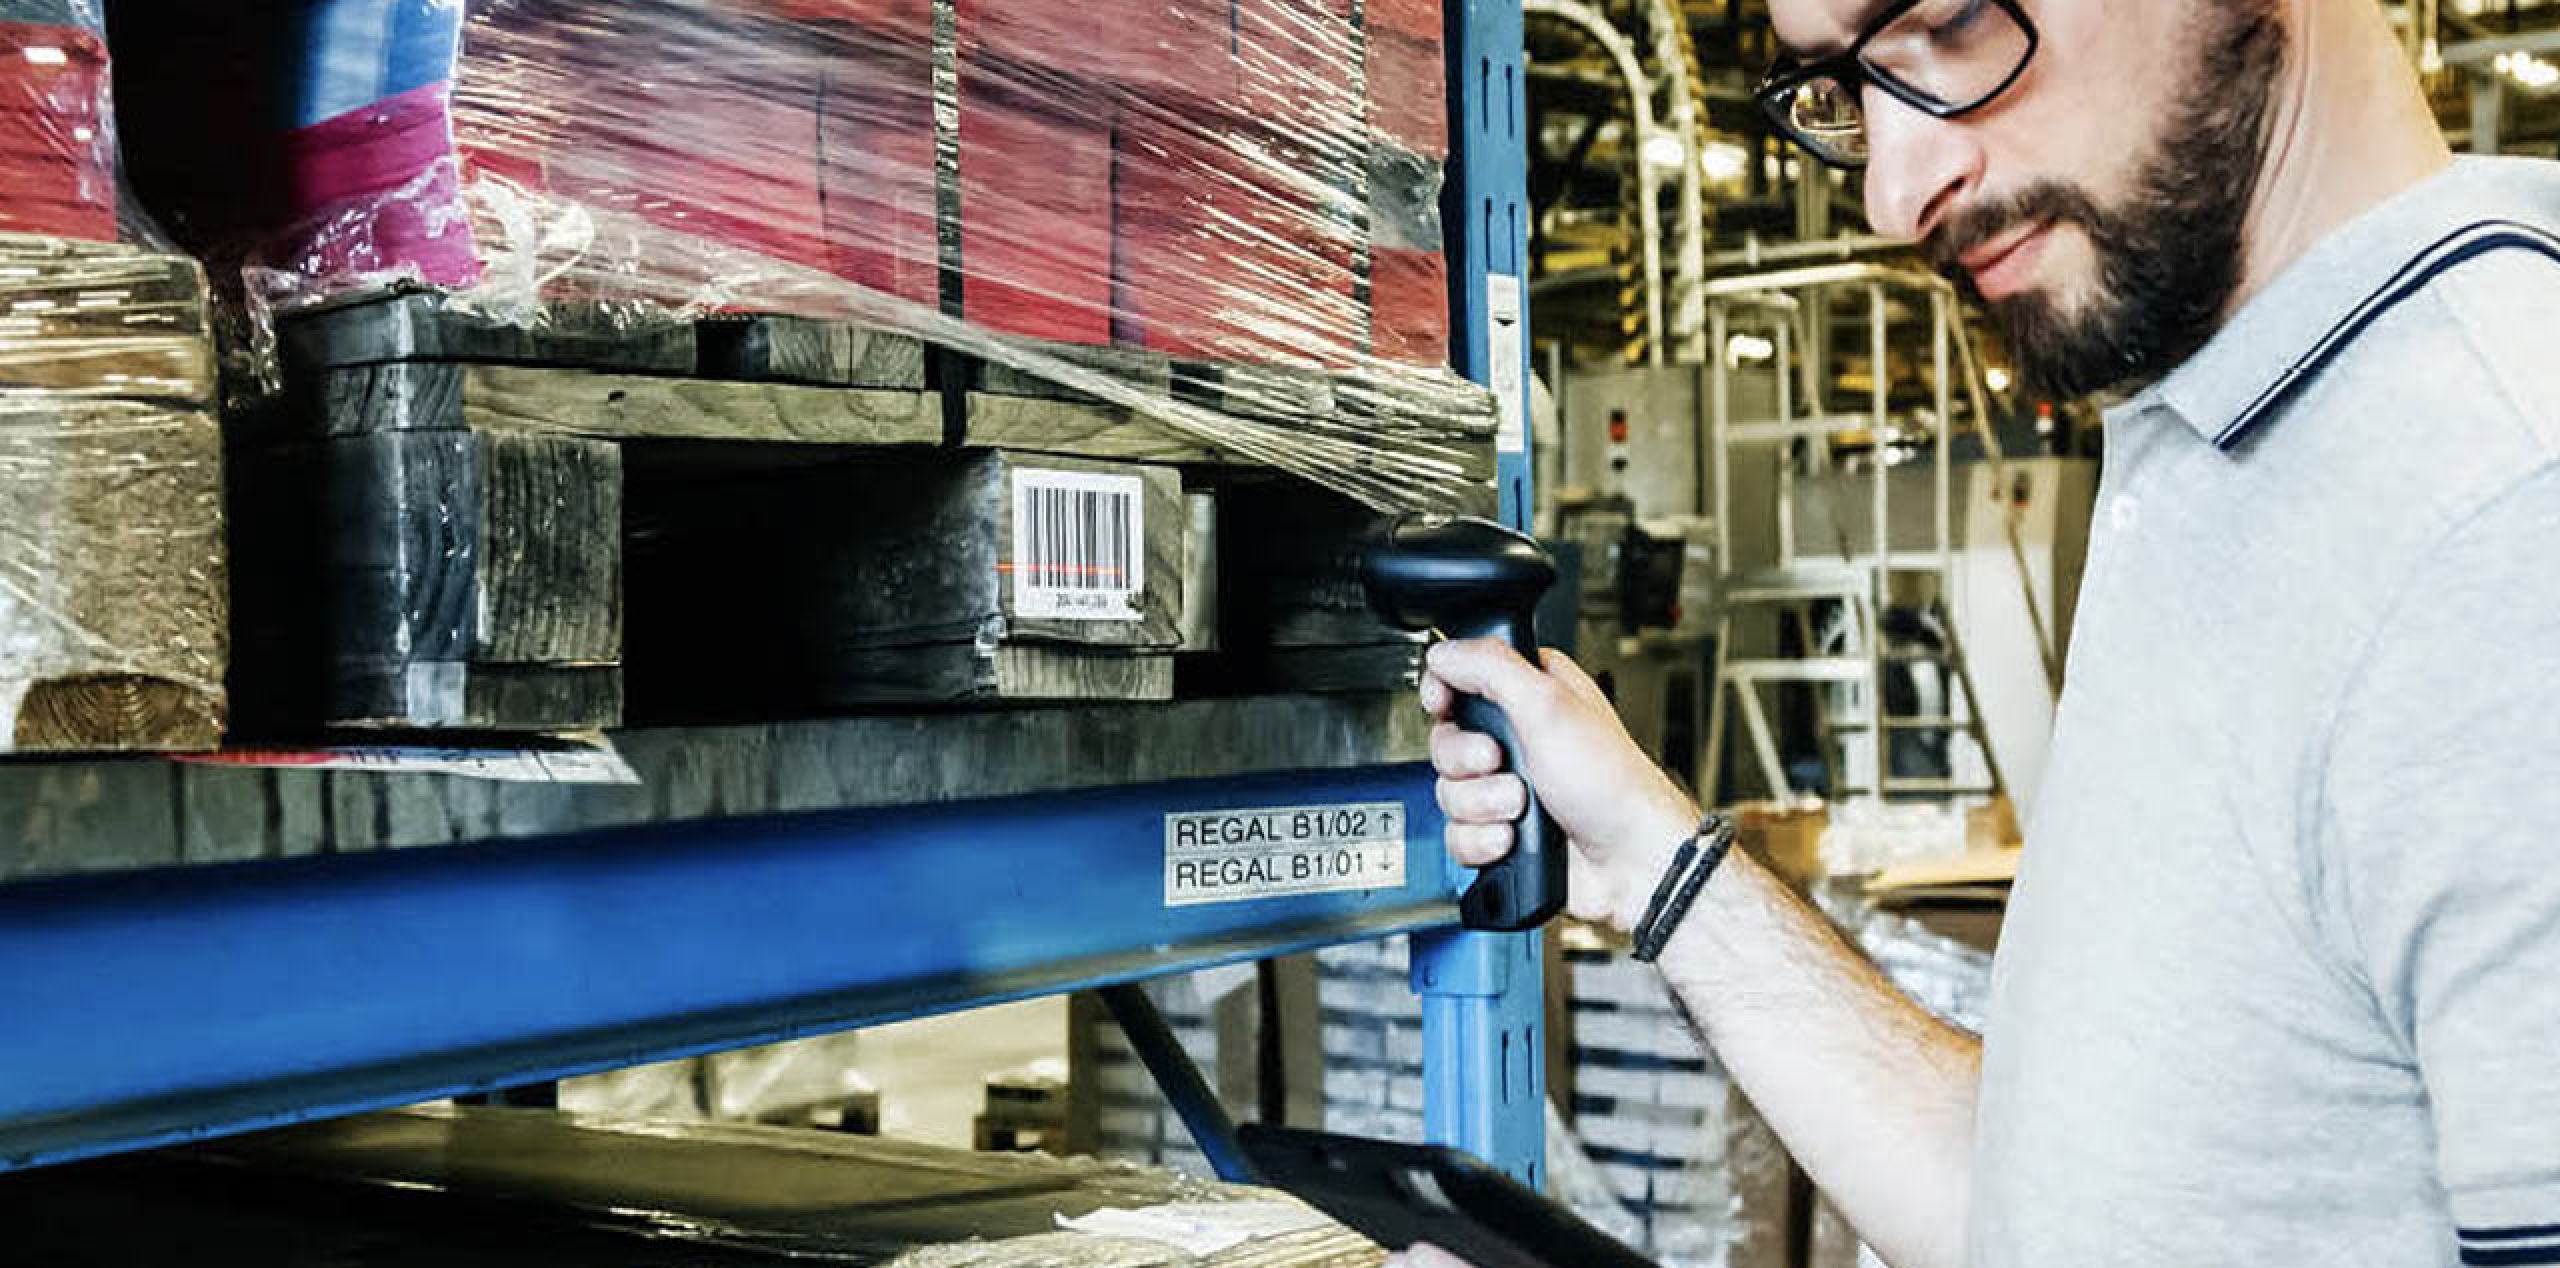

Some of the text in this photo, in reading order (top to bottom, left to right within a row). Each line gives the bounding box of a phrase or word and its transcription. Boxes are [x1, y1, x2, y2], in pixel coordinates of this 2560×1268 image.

[1176, 810, 1367, 847] REGAL B1/02
[1176, 850, 1363, 888] REGAL B1/01
